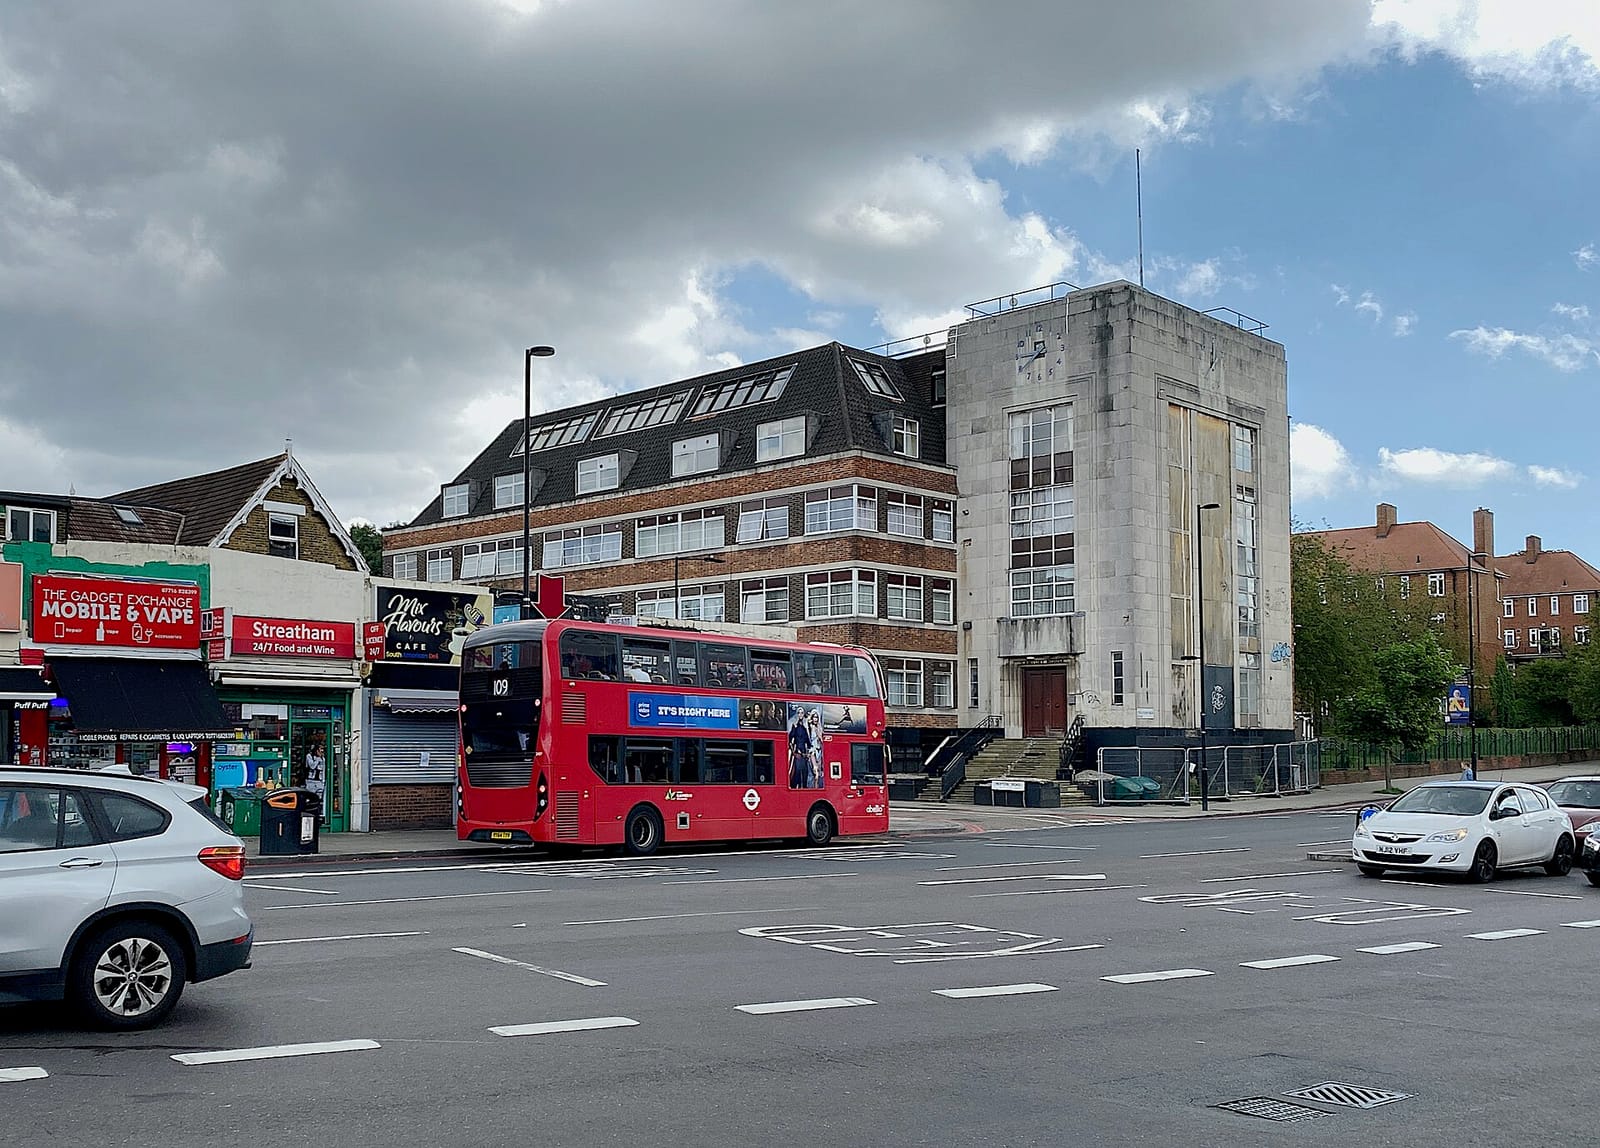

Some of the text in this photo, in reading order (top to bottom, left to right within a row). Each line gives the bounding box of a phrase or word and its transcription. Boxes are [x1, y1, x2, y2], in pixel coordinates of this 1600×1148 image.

[42, 588, 193, 608] THE GADGET EXCHANGE
[387, 594, 429, 618] Mix
[41, 600, 194, 625] MOBILE & VAPE
[369, 625, 379, 633] OFF
[382, 611, 443, 638] Flavours
[252, 621, 335, 641] Streatham
[365, 635, 383, 644] LICENCE
[252, 642, 335, 655] 24/7 Food and Wine
[368, 647, 380, 656] 24/7
[395, 642, 427, 651] CAFE
[386, 651, 402, 659] South
[493, 679, 509, 696] 109
[14, 701, 49, 709] Puff Puff
[658, 706, 731, 718] IT'S RIGHT HERE
[217, 763, 238, 771] oyster
